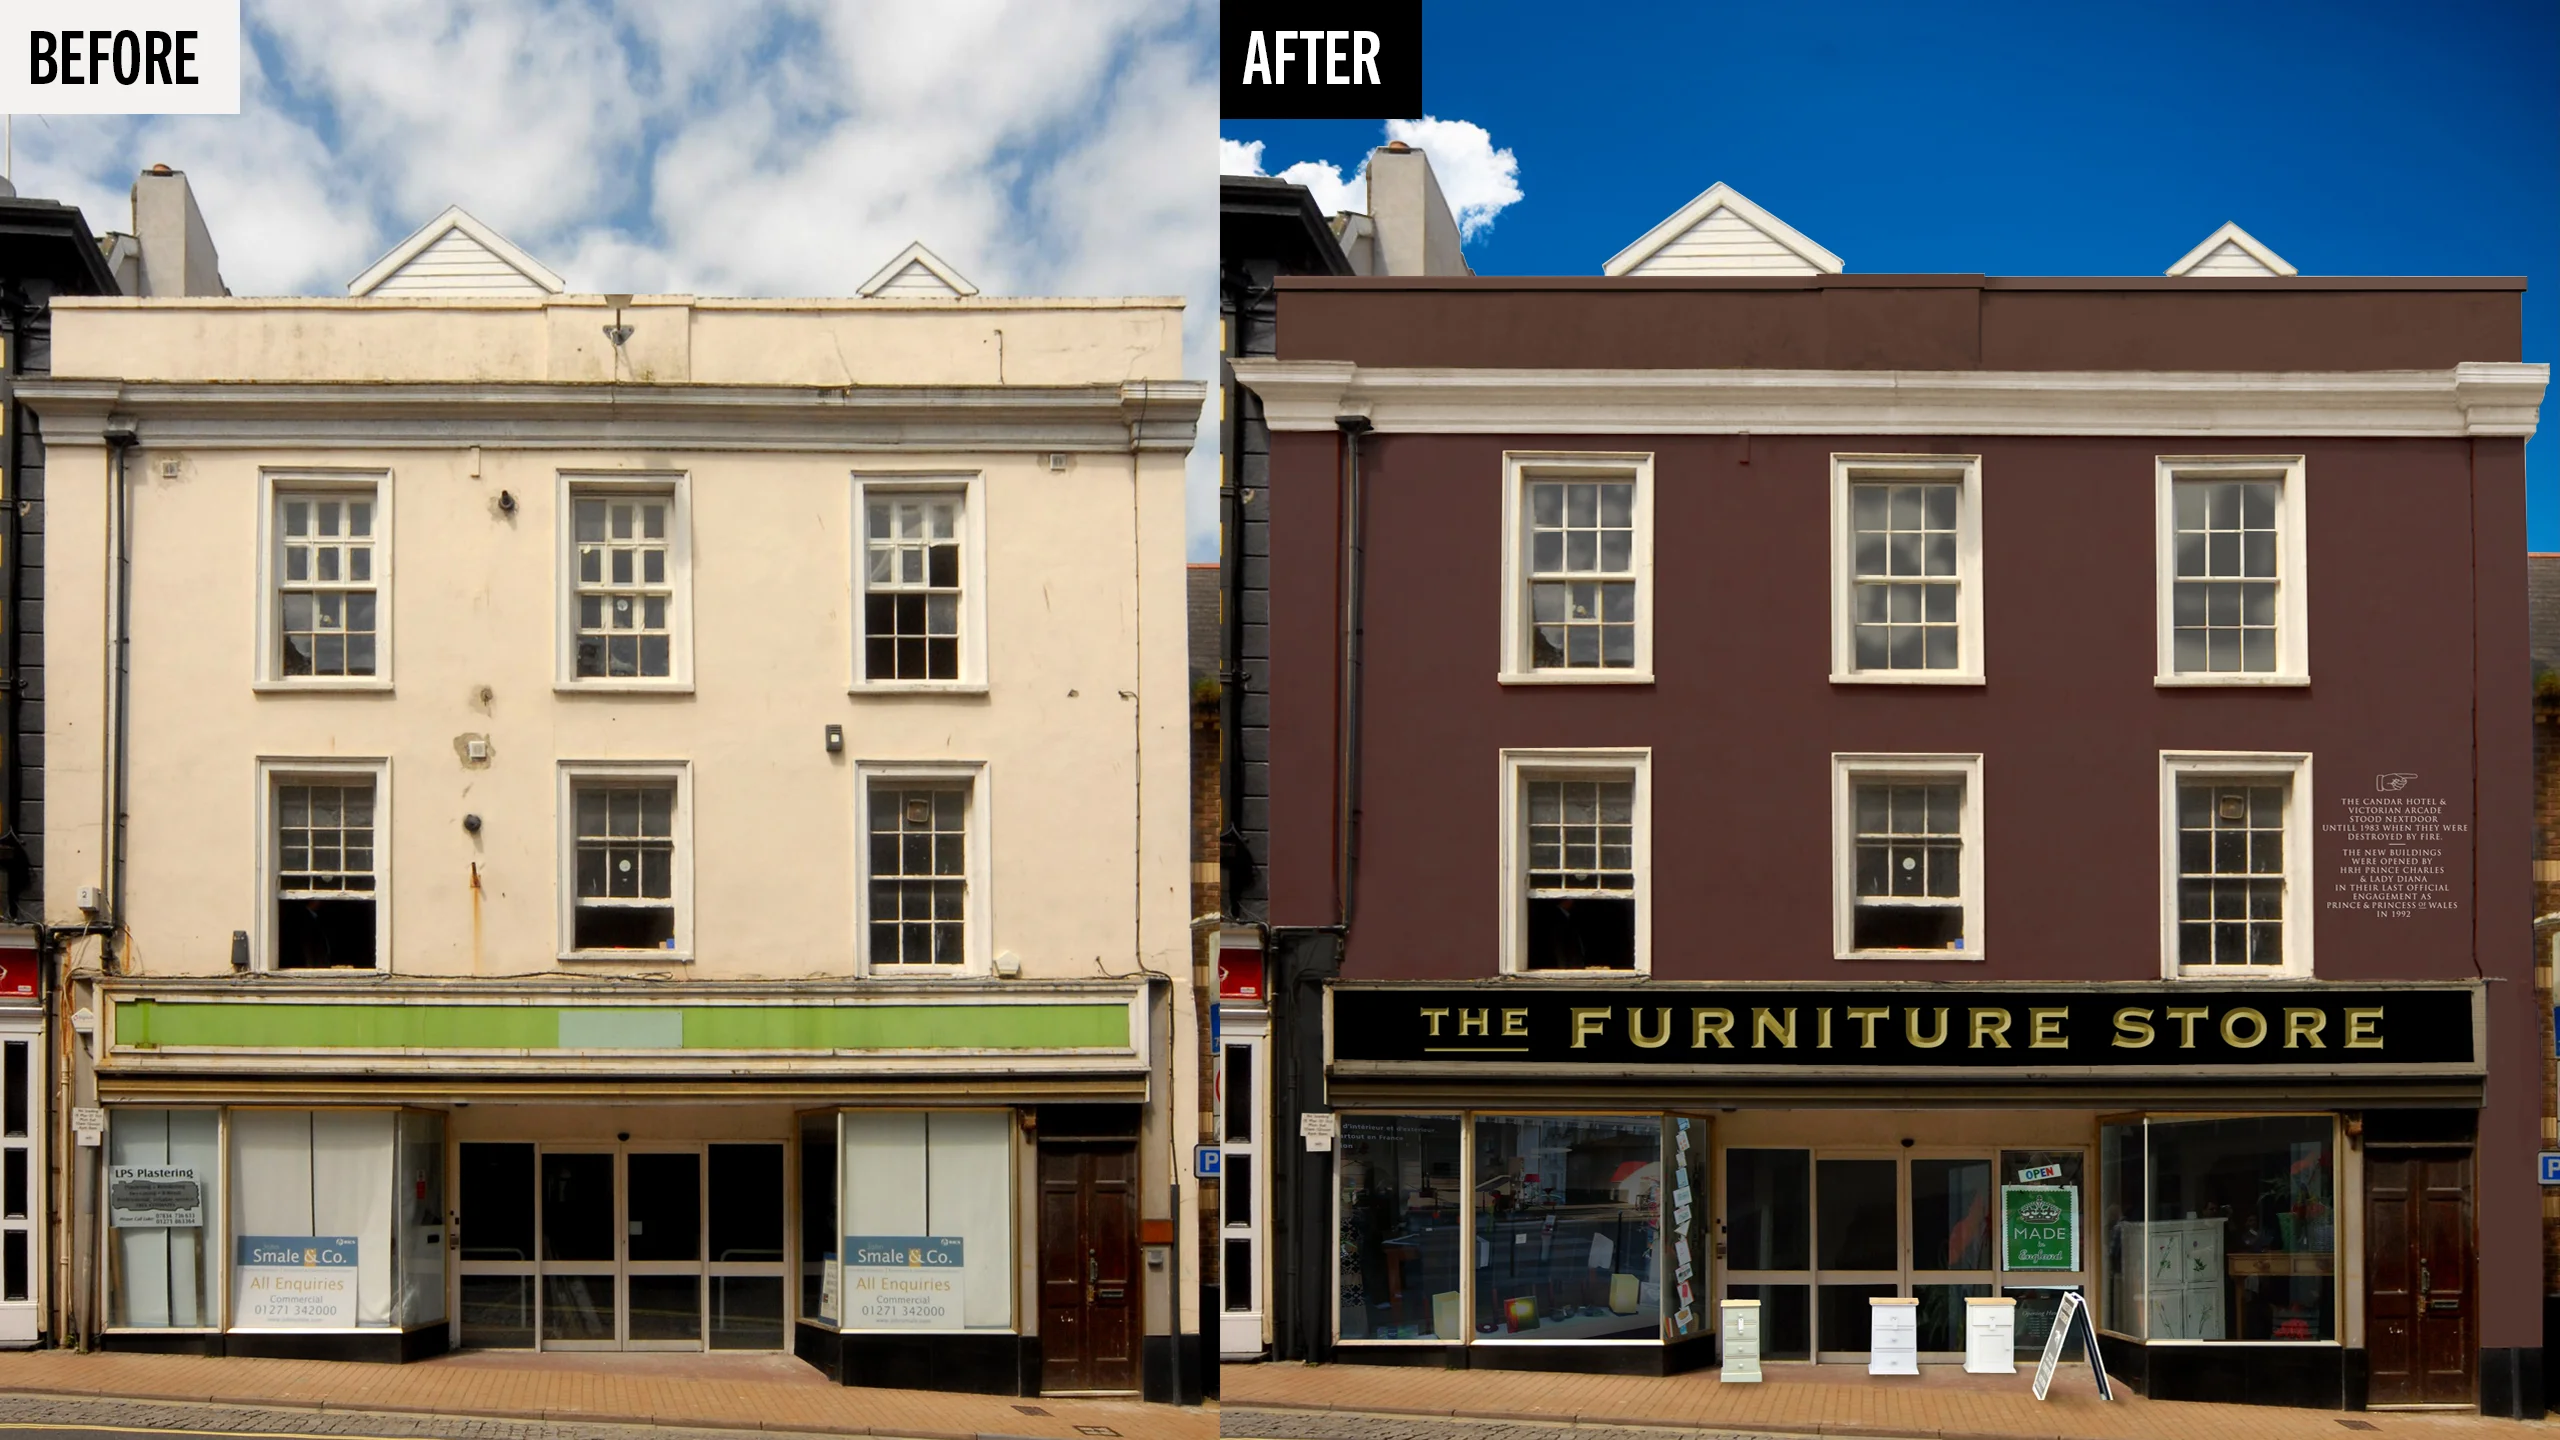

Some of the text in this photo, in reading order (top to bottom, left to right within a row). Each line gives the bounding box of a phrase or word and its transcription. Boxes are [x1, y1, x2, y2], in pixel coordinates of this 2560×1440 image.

[2341, 798, 2446, 806] THE CANDAR HOTEL &
[2348, 806, 2441, 815] VICTORIAN ARCADE
[2349, 815, 2438, 823] STOOD NEXTDOOR
[2322, 824, 2467, 832] UNTILL 1983 WHEN THEY WERE
[2347, 832, 2442, 841] DESTROYED BY FIRE.
[2342, 848, 2441, 857] THE NEW BUILDINGS
[2351, 857, 2432, 866] WERE OPENED BY
[2340, 866, 2444, 874] HRH PRINCE CHARLES
[2359, 875, 2427, 883] & LADY DIANA
[2335, 883, 2449, 892] IN THEIR LAST OFFICIAL
[2352, 892, 2431, 901] ENGAGEMENT AS
[2326, 901, 2360, 909] PRINCE
[2362, 901, 2370, 909] &
[2371, 901, 2416, 909] PRINCESS
[2428, 901, 2458, 909] WALES
[2376, 910, 2411, 918] IN 1992
[1420, 1006, 2384, 1050] THE FURNITURE STORE
[1205, 1152, 1219, 1171] P
[115, 1168, 194, 1179] LPS Plastering
[2025, 1167, 2055, 1180] OPEN
[2014, 1228, 2066, 1240] MADE
[253, 1248, 346, 1264] Smale & Co.
[858, 1249, 952, 1264] Smale & Co.
[2018, 1249, 2063, 1264] England
[250, 1276, 344, 1293] All Enquiries
[856, 1277, 951, 1293] All Enquiries
[269, 1295, 323, 1304] Commercial
[876, 1295, 931, 1304] Commercial
[254, 1305, 337, 1316] 01271 342000
[862, 1305, 946, 1317] 01271 342000
[2022, 1310, 2045, 1318] Opening
